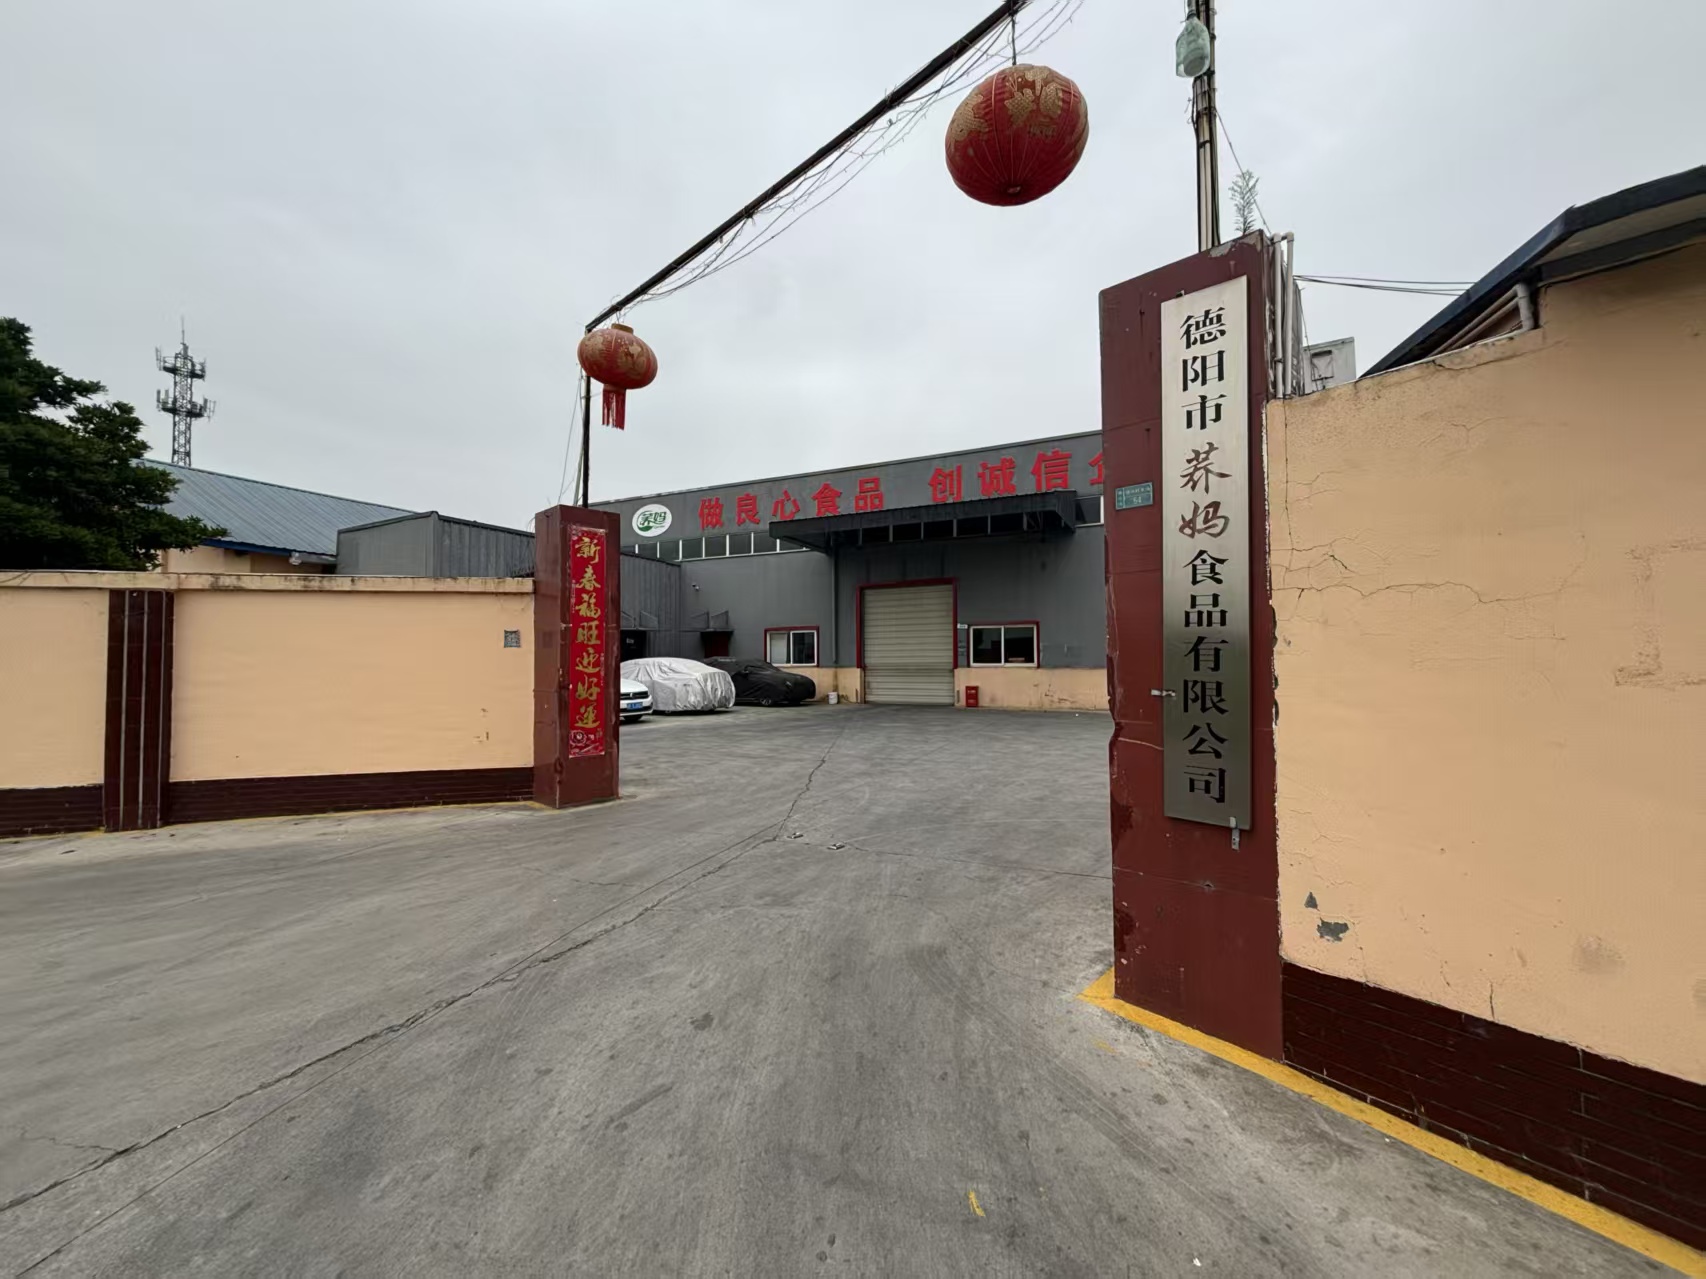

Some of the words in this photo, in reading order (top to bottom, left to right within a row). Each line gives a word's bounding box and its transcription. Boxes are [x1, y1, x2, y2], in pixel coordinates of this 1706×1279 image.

[698, 477, 884, 531] 做良心食品
[1178, 307, 1232, 804] 德阳市荞妈食品有限公司
